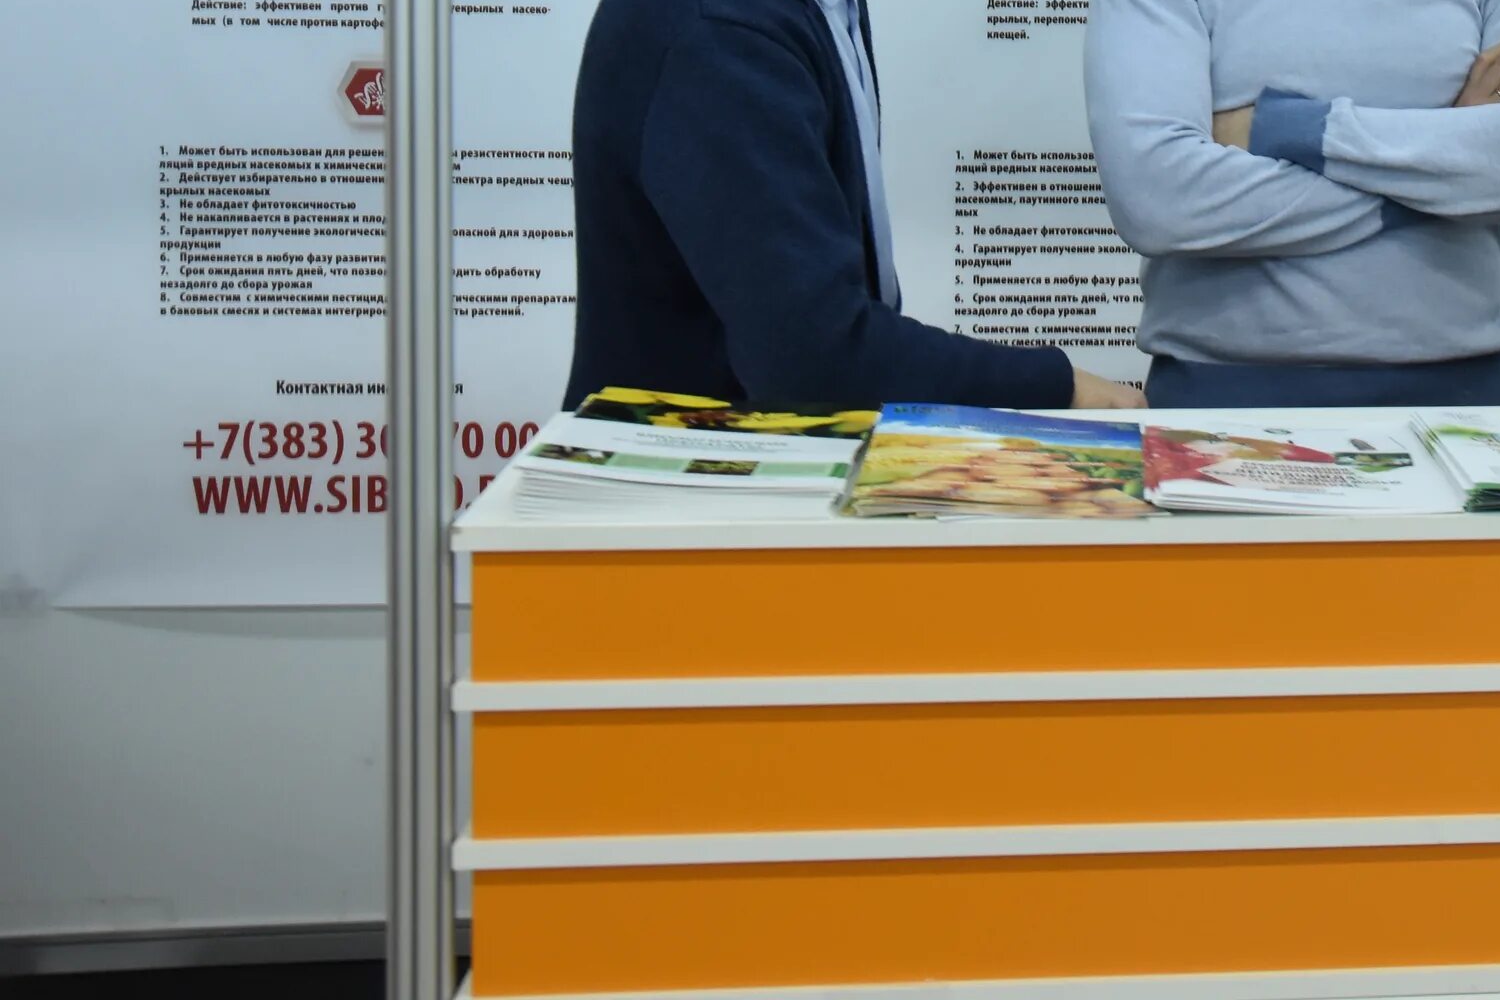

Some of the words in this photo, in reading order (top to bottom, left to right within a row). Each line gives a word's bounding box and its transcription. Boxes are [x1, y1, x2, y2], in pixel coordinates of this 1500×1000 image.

[255, 0, 322, 13] эффективен
[330, 3, 369, 14] против
[512, 6, 551, 14] насеко-
[266, 18, 298, 26] числе
[300, 18, 339, 29] против
[986, 15, 1032, 26] крылых,
[986, 29, 1030, 40] клещей.
[178, 145, 216, 156] Может
[218, 145, 248, 156] быть
[250, 148, 322, 157] использован
[460, 150, 546, 160] резистентности
[973, 149, 1008, 160] Может
[1010, 150, 1038, 160] быть
[159, 159, 194, 170] ляций
[196, 161, 247, 171] вредных
[249, 161, 312, 170] насекомых
[989, 165, 1037, 175] вредных
[1039, 165, 1097, 173] насекомых
[178, 172, 236, 184] Действует
[238, 173, 318, 185] избирательно
[495, 176, 544, 187] вредных
[159, 187, 205, 198] крылых
[207, 187, 271, 196] насекомых
[972, 181, 1038, 193] Эффективен
[195, 199, 249, 211] обладает
[251, 200, 357, 211] фитотоксичностью
[954, 196, 1016, 205] насекомых,
[1018, 196, 1079, 206] паутинного
[196, 214, 281, 223] накапливается
[293, 214, 350, 225] растениях
[179, 225, 248, 238] Гарантирует
[251, 227, 311, 238] получение
[522, 229, 574, 240] здоровья
[988, 225, 1038, 237] обладает
[159, 240, 221, 251] продукции
[972, 243, 1038, 256] Гарантирует
[1039, 245, 1096, 255] получение
[179, 251, 254, 264] Применяется
[265, 252, 304, 265] любую
[306, 253, 333, 265] фазу
[954, 258, 1012, 268] продукции
[179, 265, 205, 278] Срок
[207, 267, 265, 277] ожидания
[295, 265, 327, 278] дней,
[484, 266, 541, 279] обработку
[159, 280, 218, 290] незадолго
[271, 280, 313, 291] урожая
[972, 274, 1042, 286] Применяется
[1052, 274, 1089, 286] любую
[179, 292, 241, 302] Совместим
[253, 294, 330, 302] химическими
[972, 292, 996, 305] Срок
[998, 295, 1052, 304] ожидания
[169, 305, 219, 315] баковых
[272, 307, 322, 315] системах
[470, 307, 524, 318] растений.
[954, 307, 1008, 317] незадолго
[1057, 307, 1096, 318] урожая
[972, 324, 1030, 334] Совместим
[1041, 325, 1112, 334] химическими
[1058, 338, 1105, 347] системах
[276, 380, 364, 395] Контактная
[183, 420, 345, 465] +7(383)
